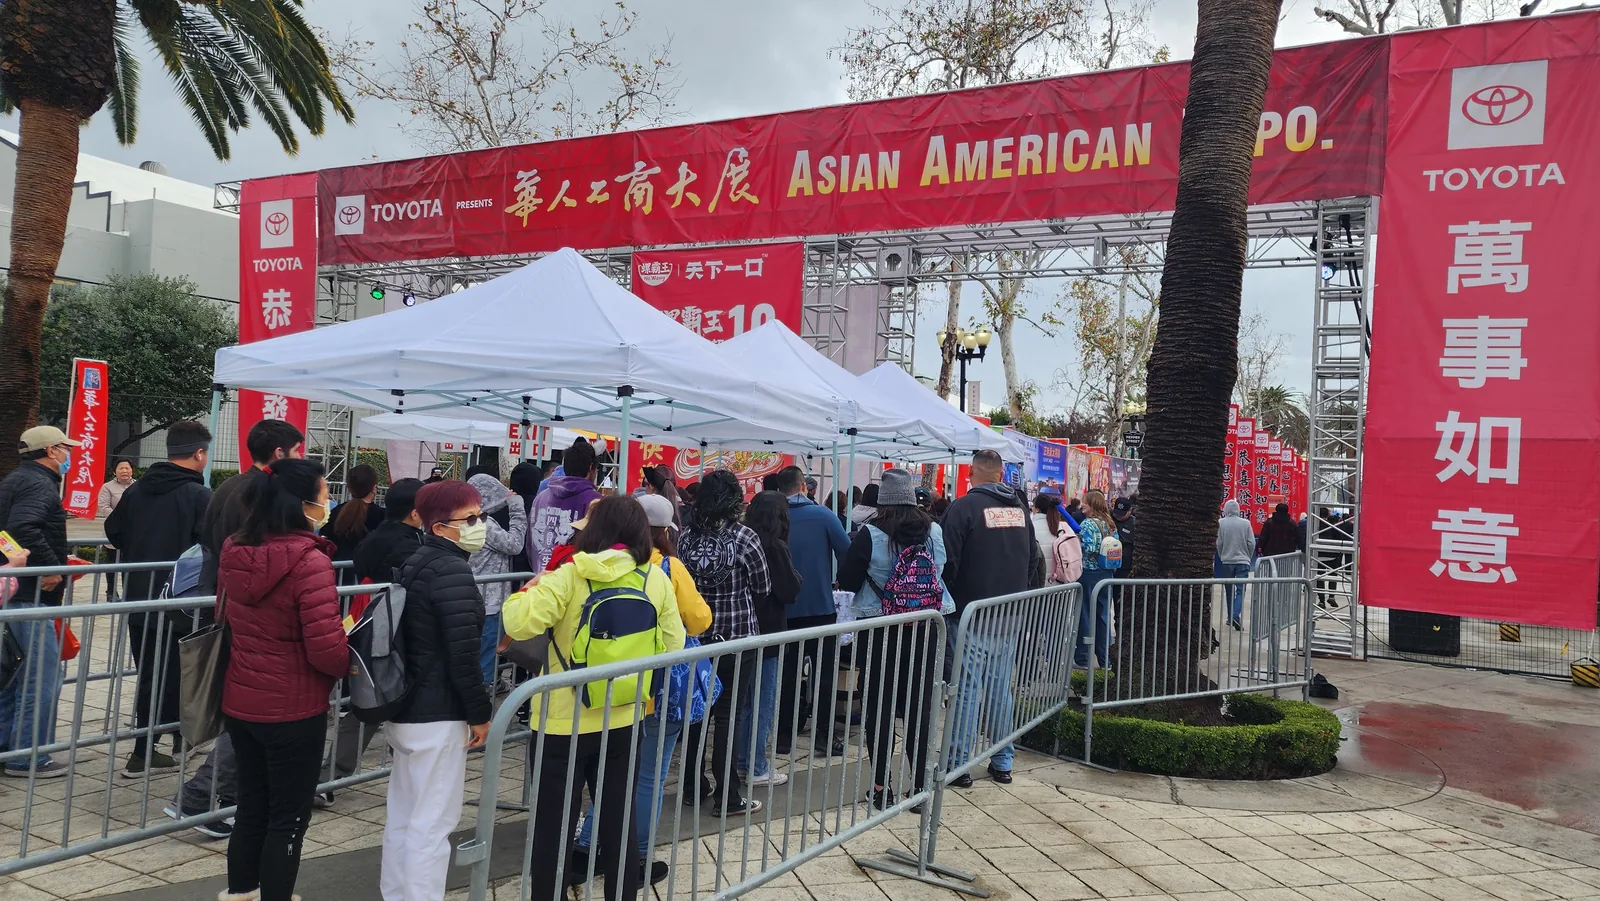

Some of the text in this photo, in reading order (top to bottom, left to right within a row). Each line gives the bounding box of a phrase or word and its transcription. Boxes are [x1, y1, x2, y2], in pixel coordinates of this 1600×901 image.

[787, 105, 1334, 198] ASIAN AMERICAN PO.
[505, 149, 759, 227] 華人工商大展
[1422, 162, 1566, 192] TOYOTA
[371, 198, 493, 223] TOYOTA PRESENTS
[252, 256, 303, 273] TOYOTA
[1428, 219, 1533, 584] 萬事如意
[508, 423, 550, 441] EXIT
